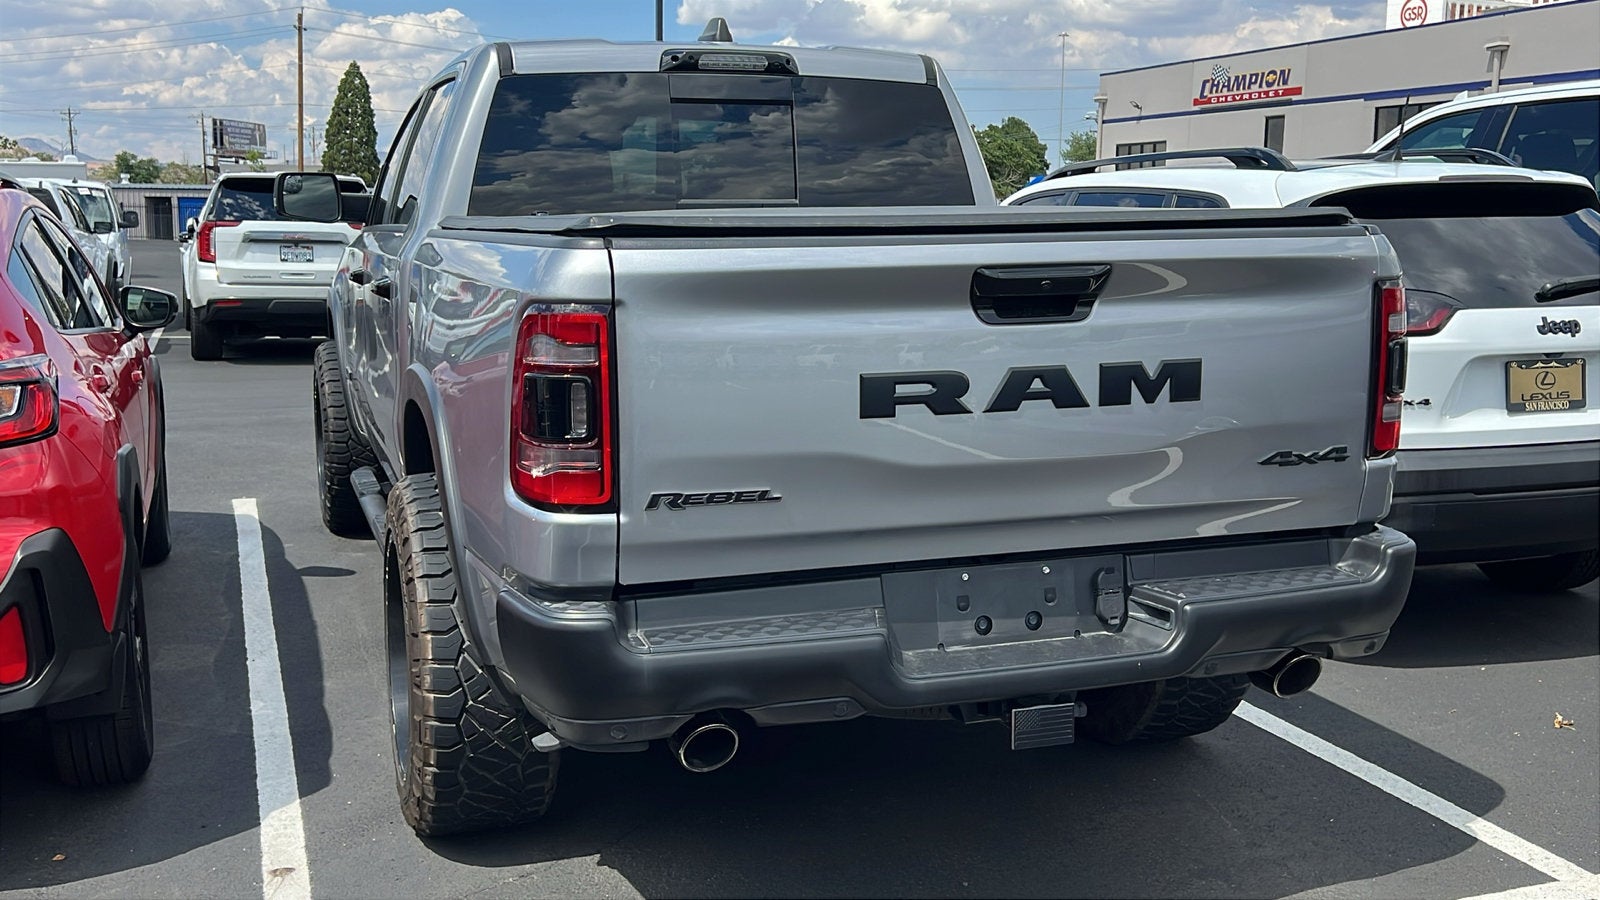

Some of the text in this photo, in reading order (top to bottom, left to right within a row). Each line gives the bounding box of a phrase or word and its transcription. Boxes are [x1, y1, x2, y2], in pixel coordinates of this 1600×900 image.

[1403, 5, 1424, 22] GSR
[1199, 68, 1292, 99] CHAMPION
[1210, 90, 1285, 104] CHEVROLET
[1536, 316, 1581, 338] Jeep
[859, 357, 1203, 420] RAM
[1521, 391, 1571, 402] LEXUS
[1525, 400, 1570, 412] SAN FRANCISCO
[1257, 444, 1351, 467] 4x4
[644, 488, 782, 512] REBEL
